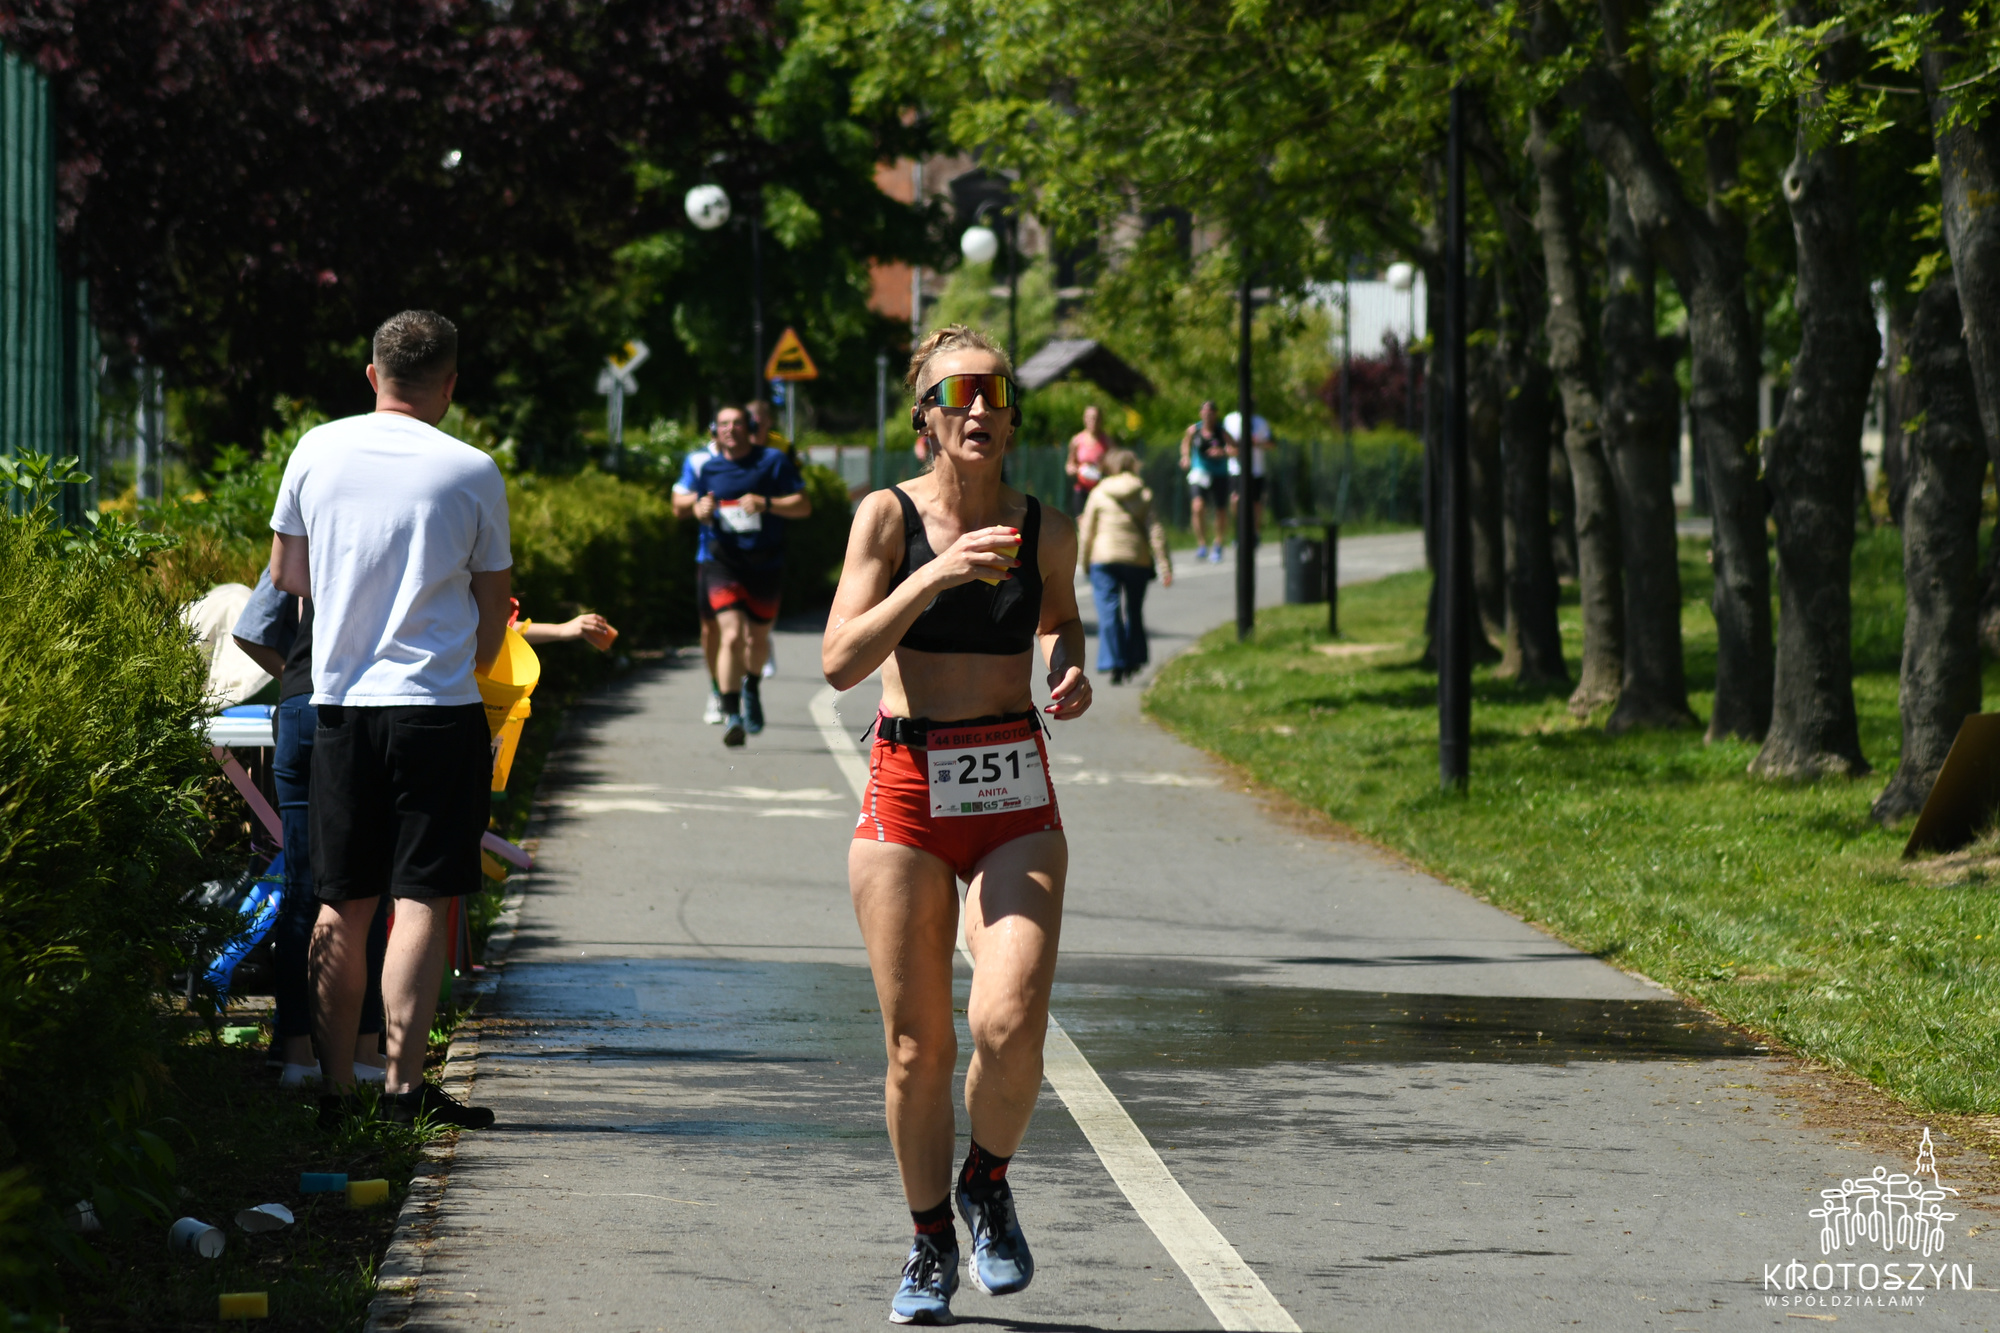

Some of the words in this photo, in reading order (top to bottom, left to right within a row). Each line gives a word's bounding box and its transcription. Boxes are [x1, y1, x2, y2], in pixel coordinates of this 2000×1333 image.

[934, 735, 950, 746] 44
[953, 733, 982, 745] BIEG
[956, 749, 1019, 784] 251
[977, 787, 1008, 798] ANITA
